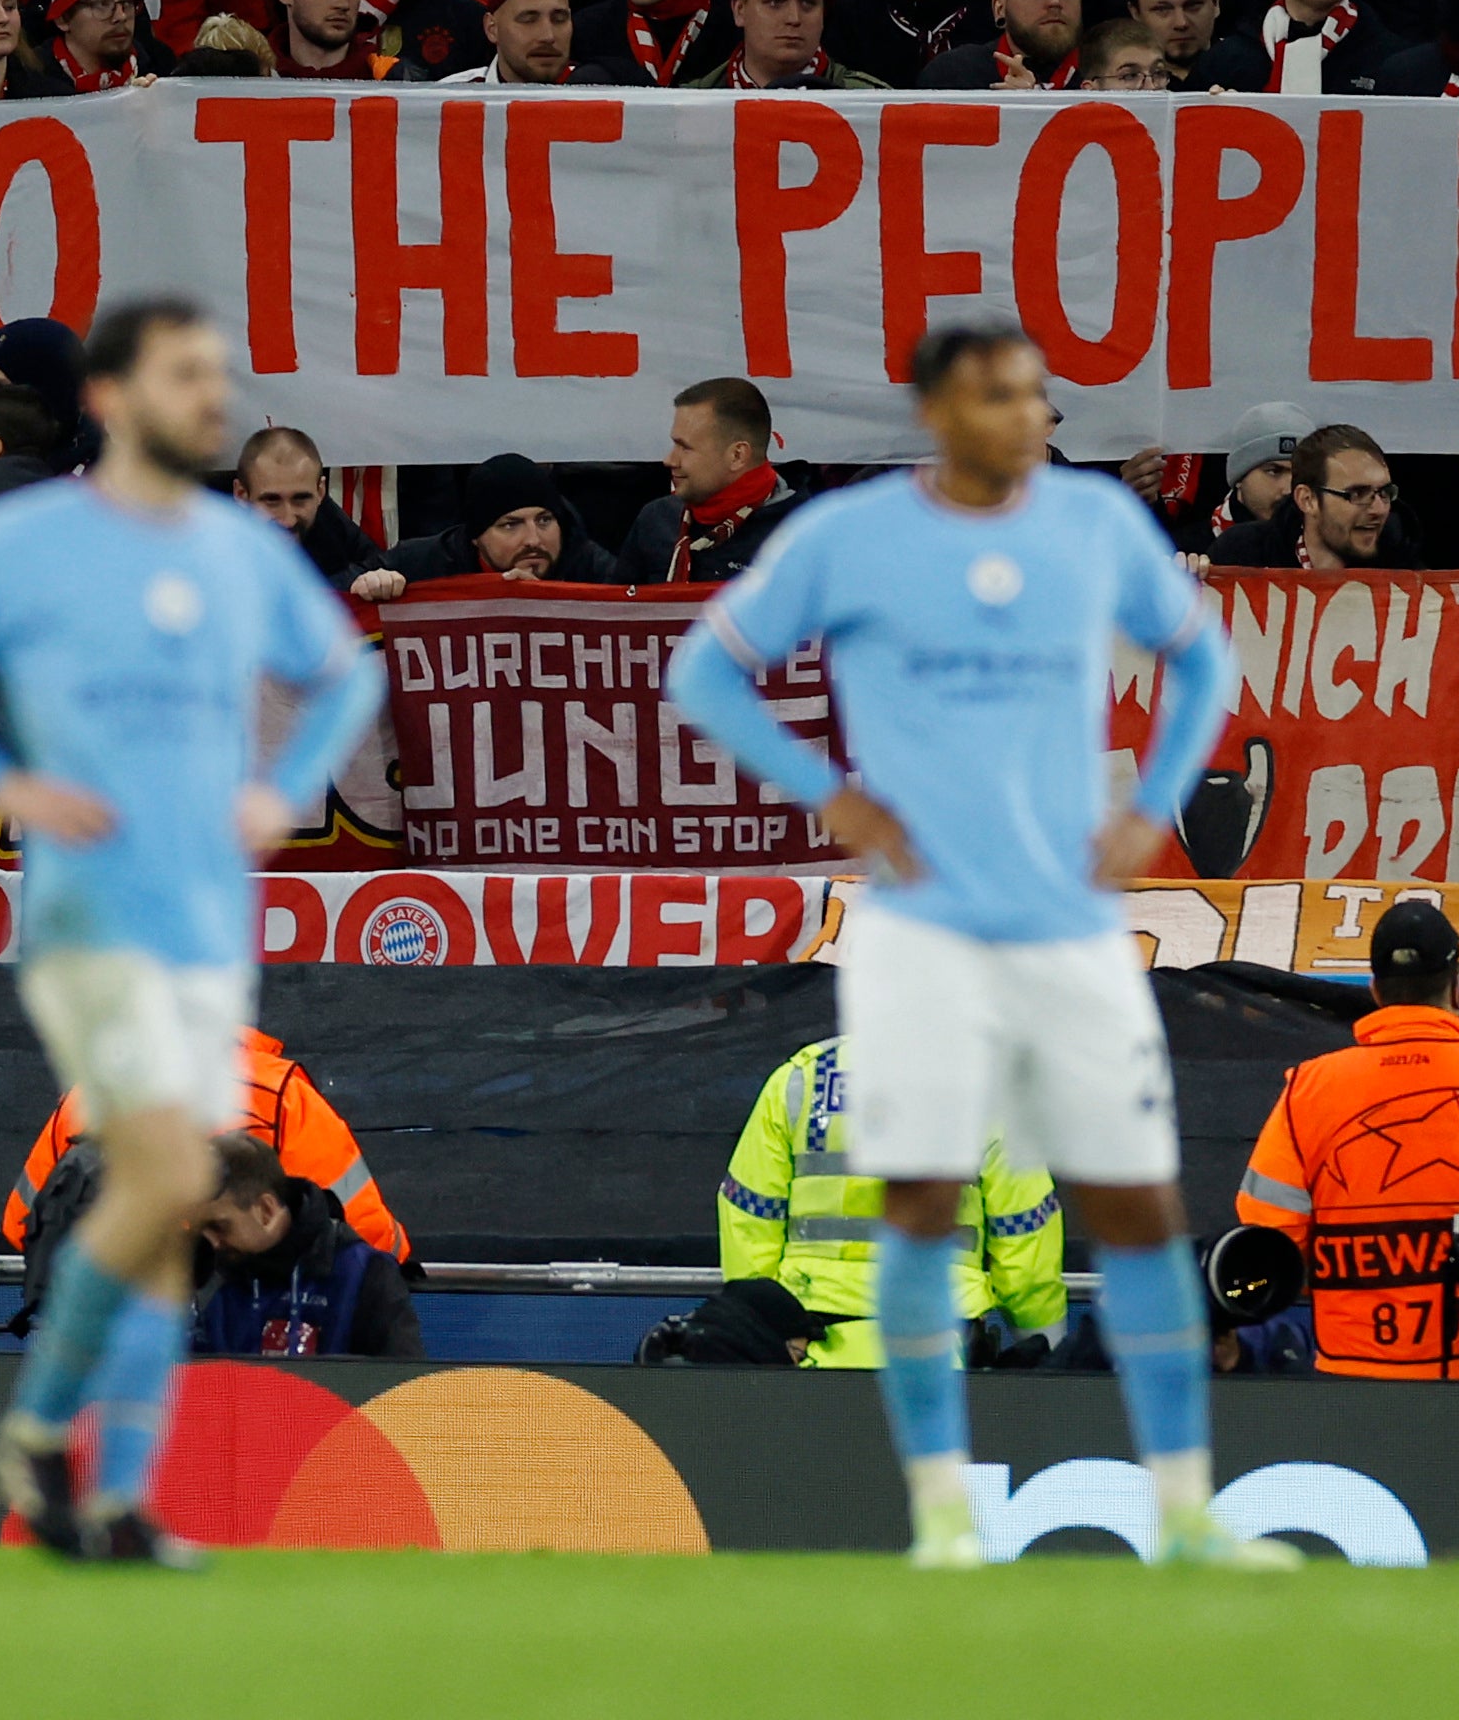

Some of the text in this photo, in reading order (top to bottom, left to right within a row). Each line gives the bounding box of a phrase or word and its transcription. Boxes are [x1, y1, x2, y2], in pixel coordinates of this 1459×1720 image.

[196, 97, 638, 376] THE
[407, 817, 458, 857] NO
[474, 817, 560, 855] ONE
[575, 817, 656, 853] CAN
[671, 816, 786, 854] STOP
[385, 908, 435, 939] BAYERN
